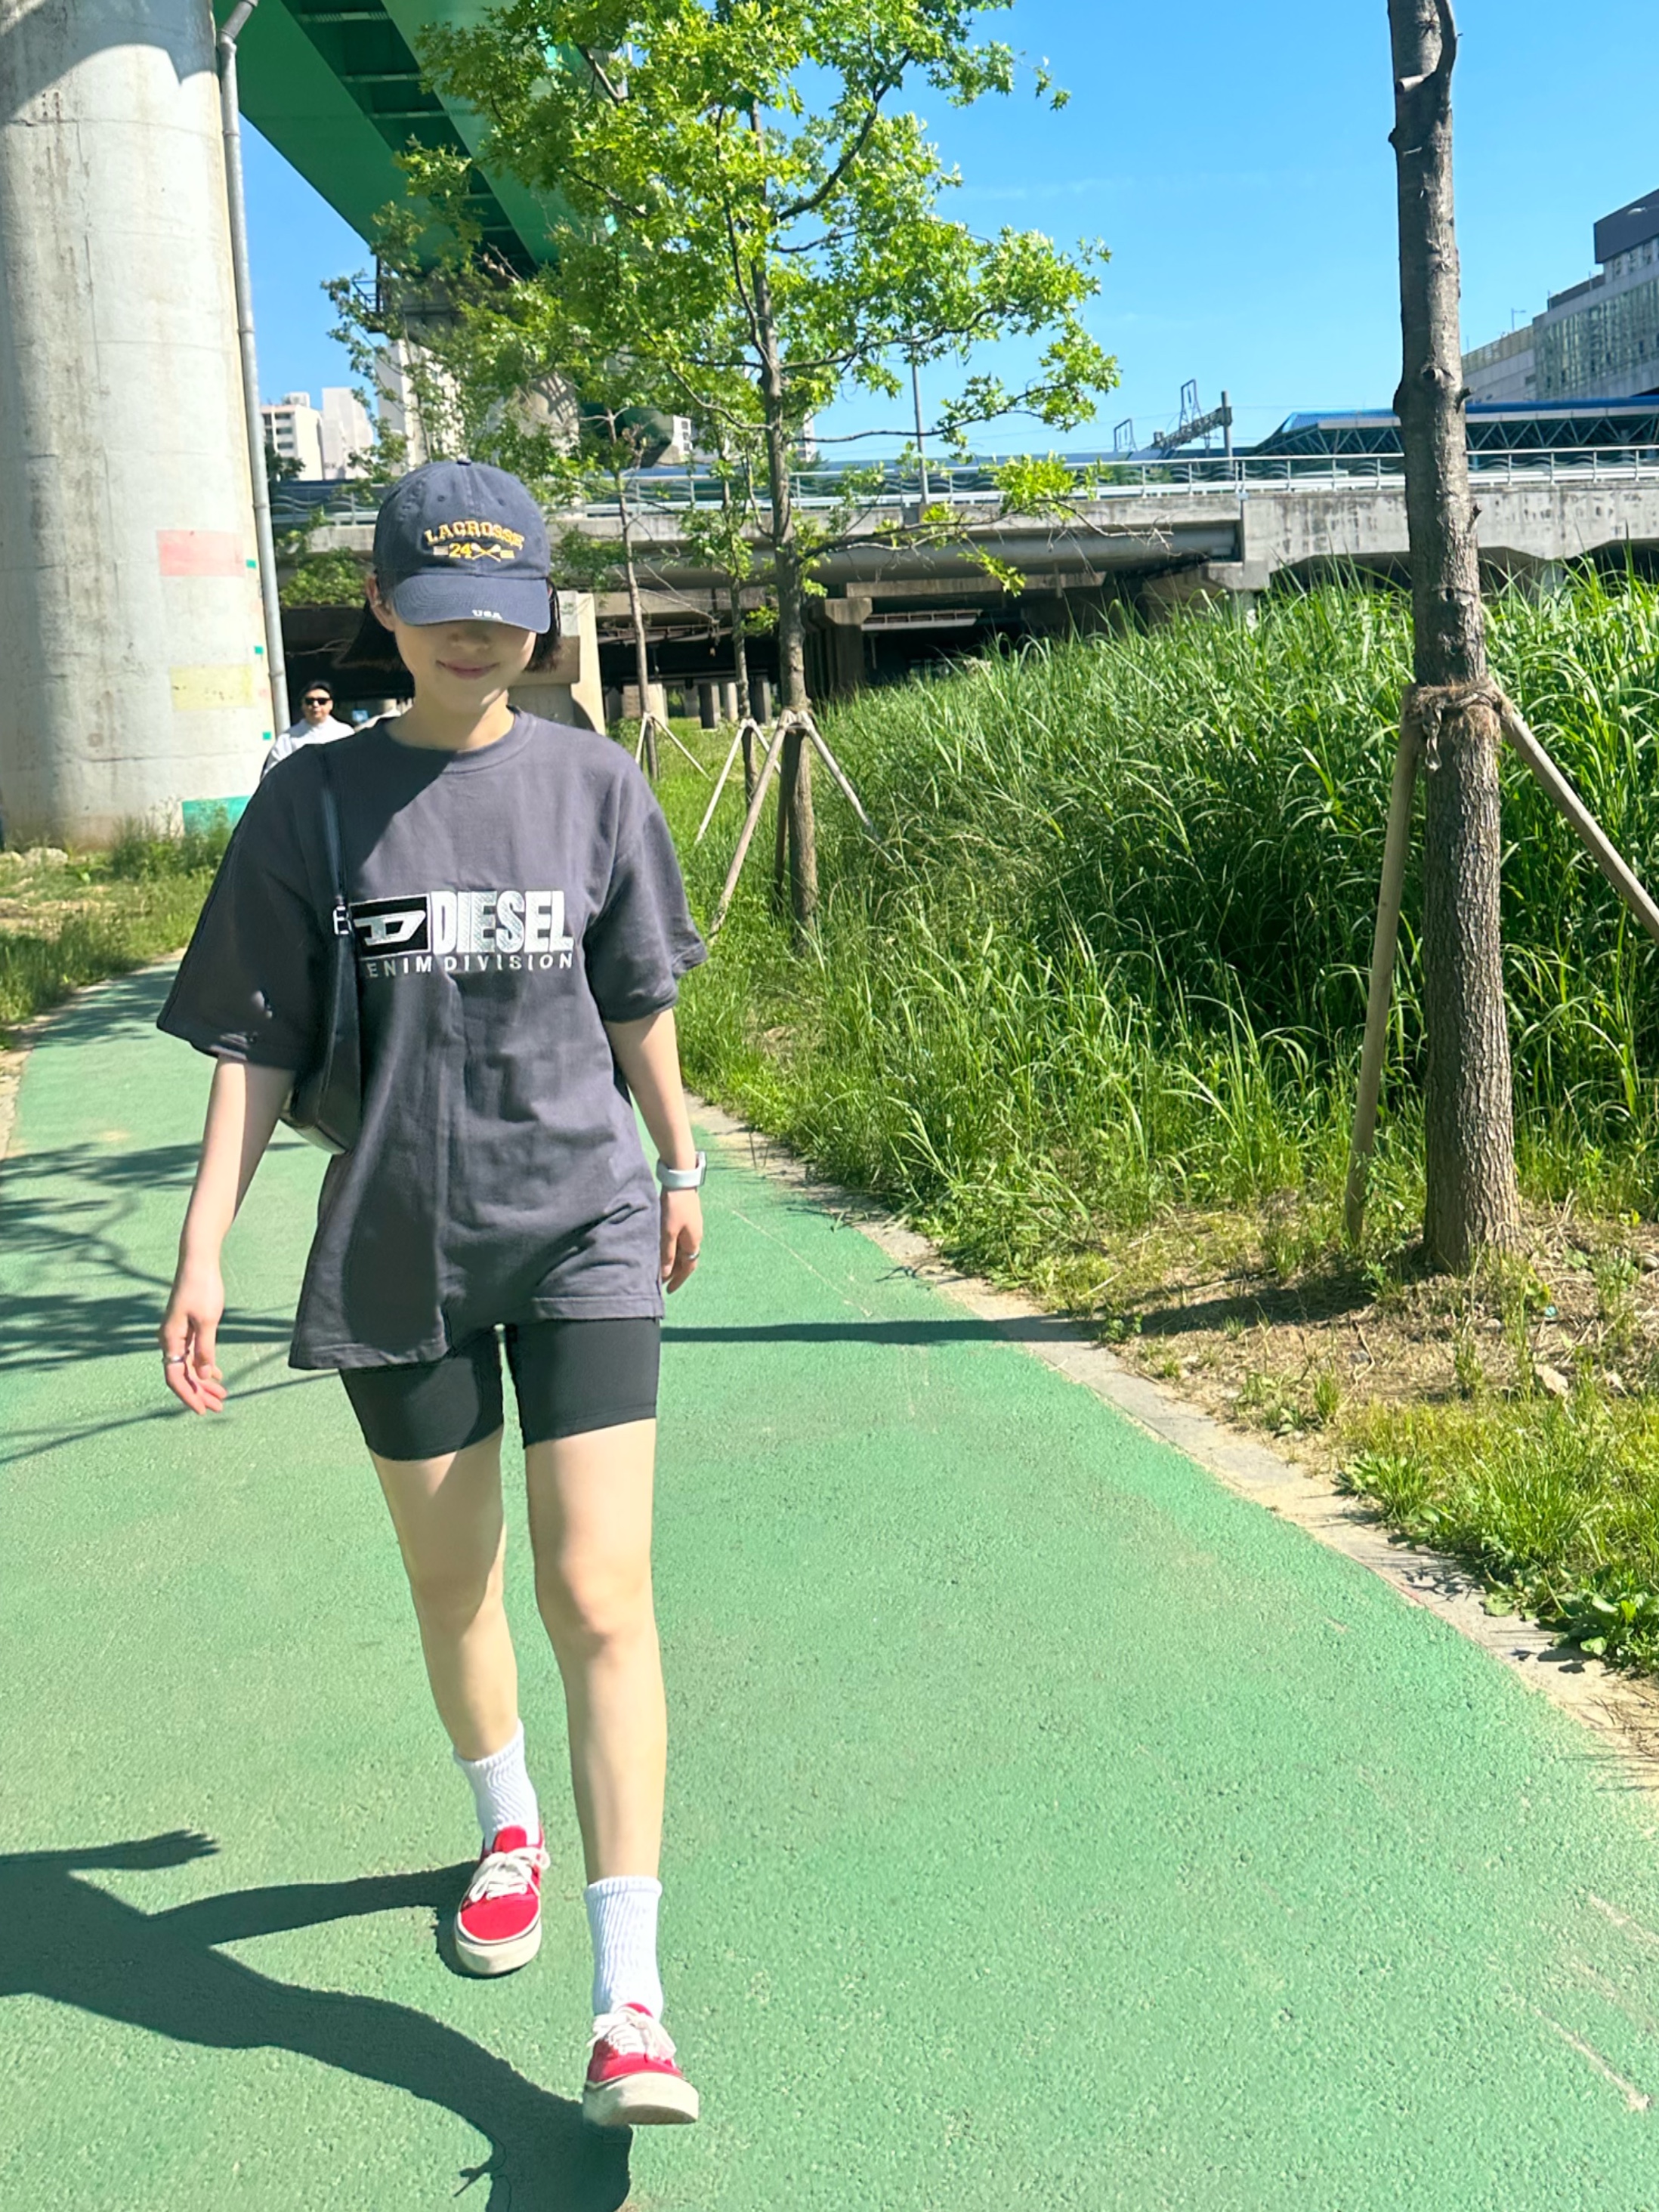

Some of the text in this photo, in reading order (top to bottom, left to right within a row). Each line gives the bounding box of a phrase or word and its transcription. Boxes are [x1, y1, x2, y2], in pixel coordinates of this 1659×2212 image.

[425, 520, 525, 551] LACROSSE
[449, 542, 472, 558] 24
[472, 609, 503, 619] USA
[431, 891, 573, 955] DIESEL
[366, 953, 573, 978] ENIM DIVISION
